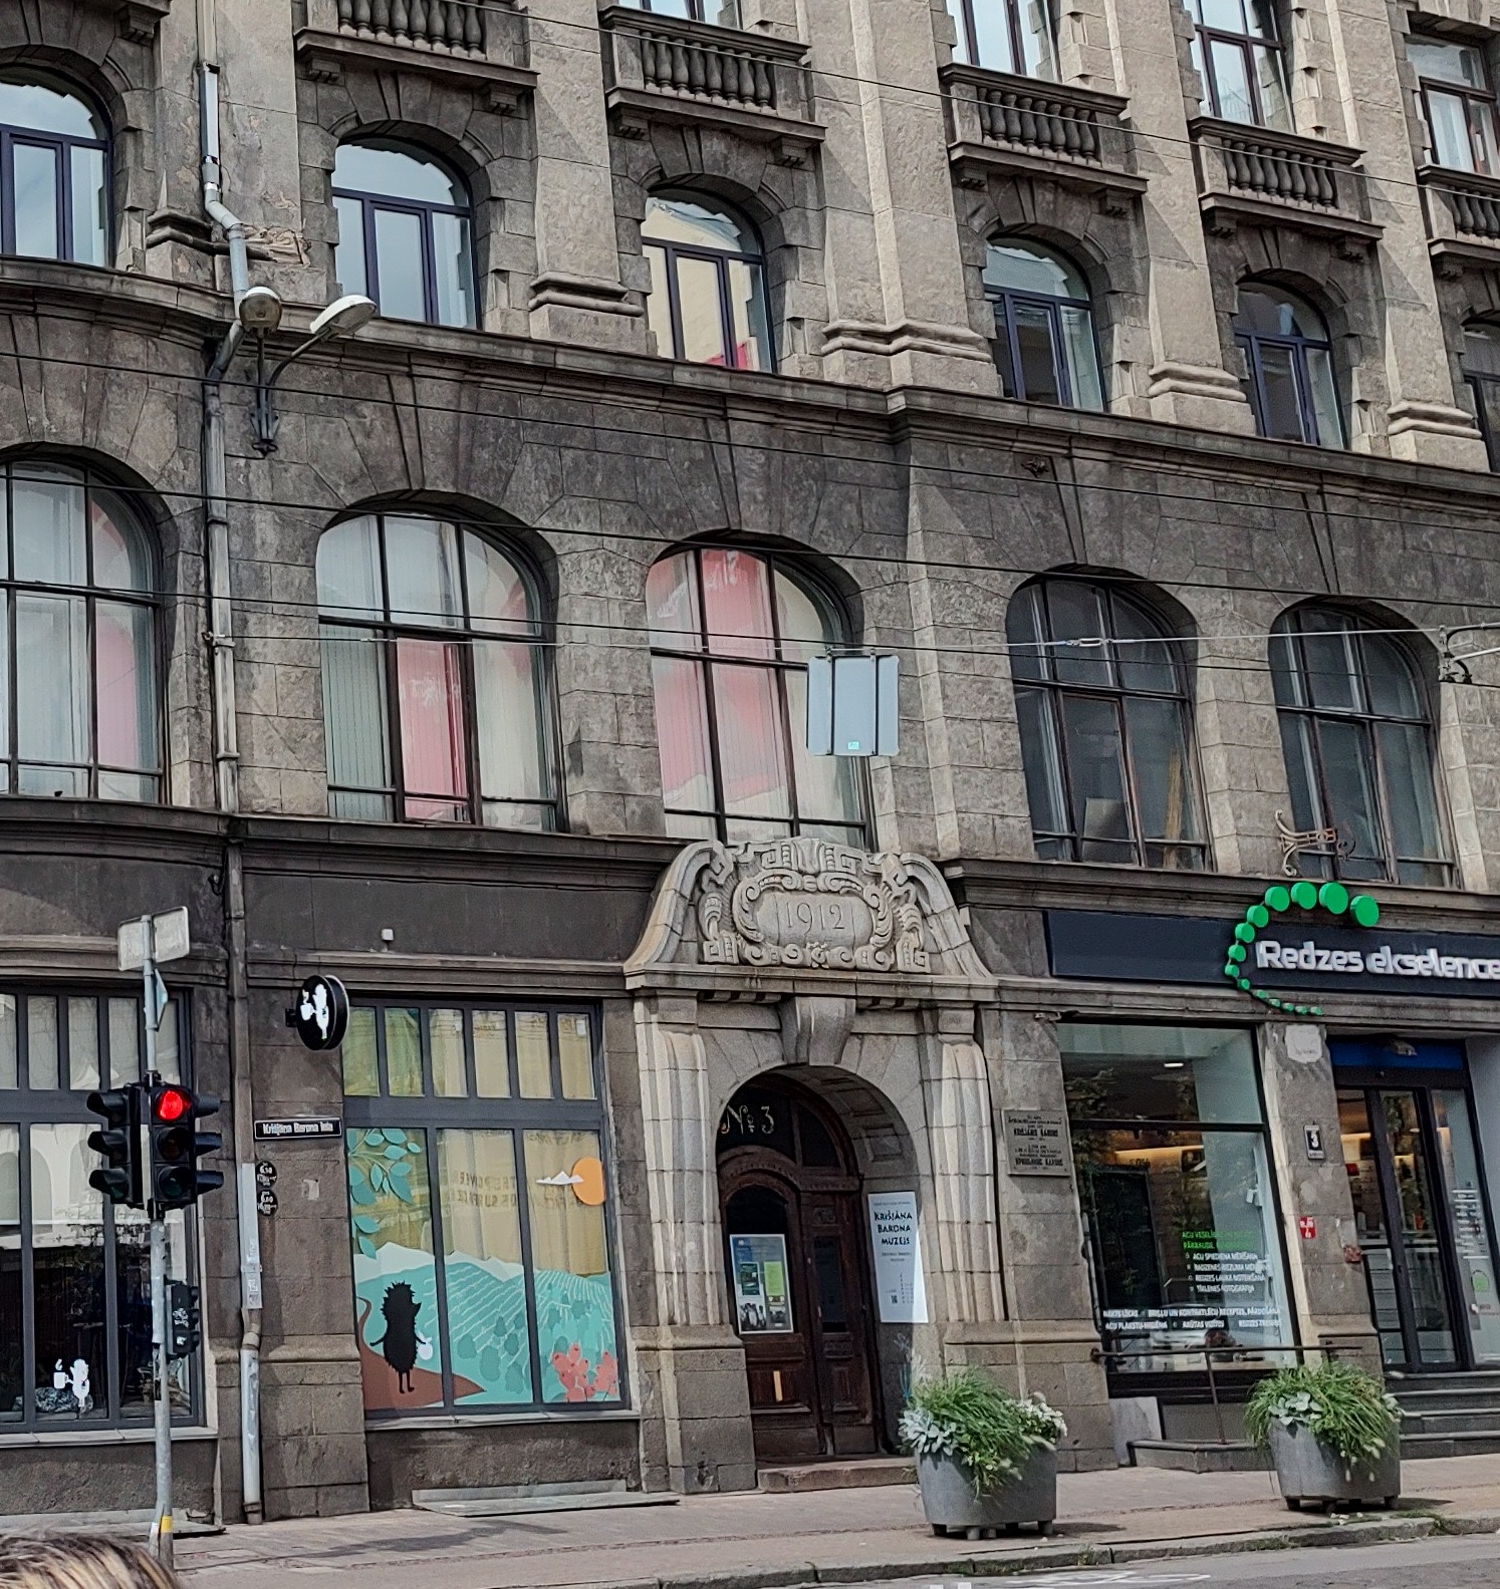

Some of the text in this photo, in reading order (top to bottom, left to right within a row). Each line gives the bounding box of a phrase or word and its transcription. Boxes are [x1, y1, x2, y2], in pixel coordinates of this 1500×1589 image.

[787, 901, 846, 935] 1912
[1255, 940, 1365, 973] Redzes
[1310, 1130, 1320, 1148] 3
